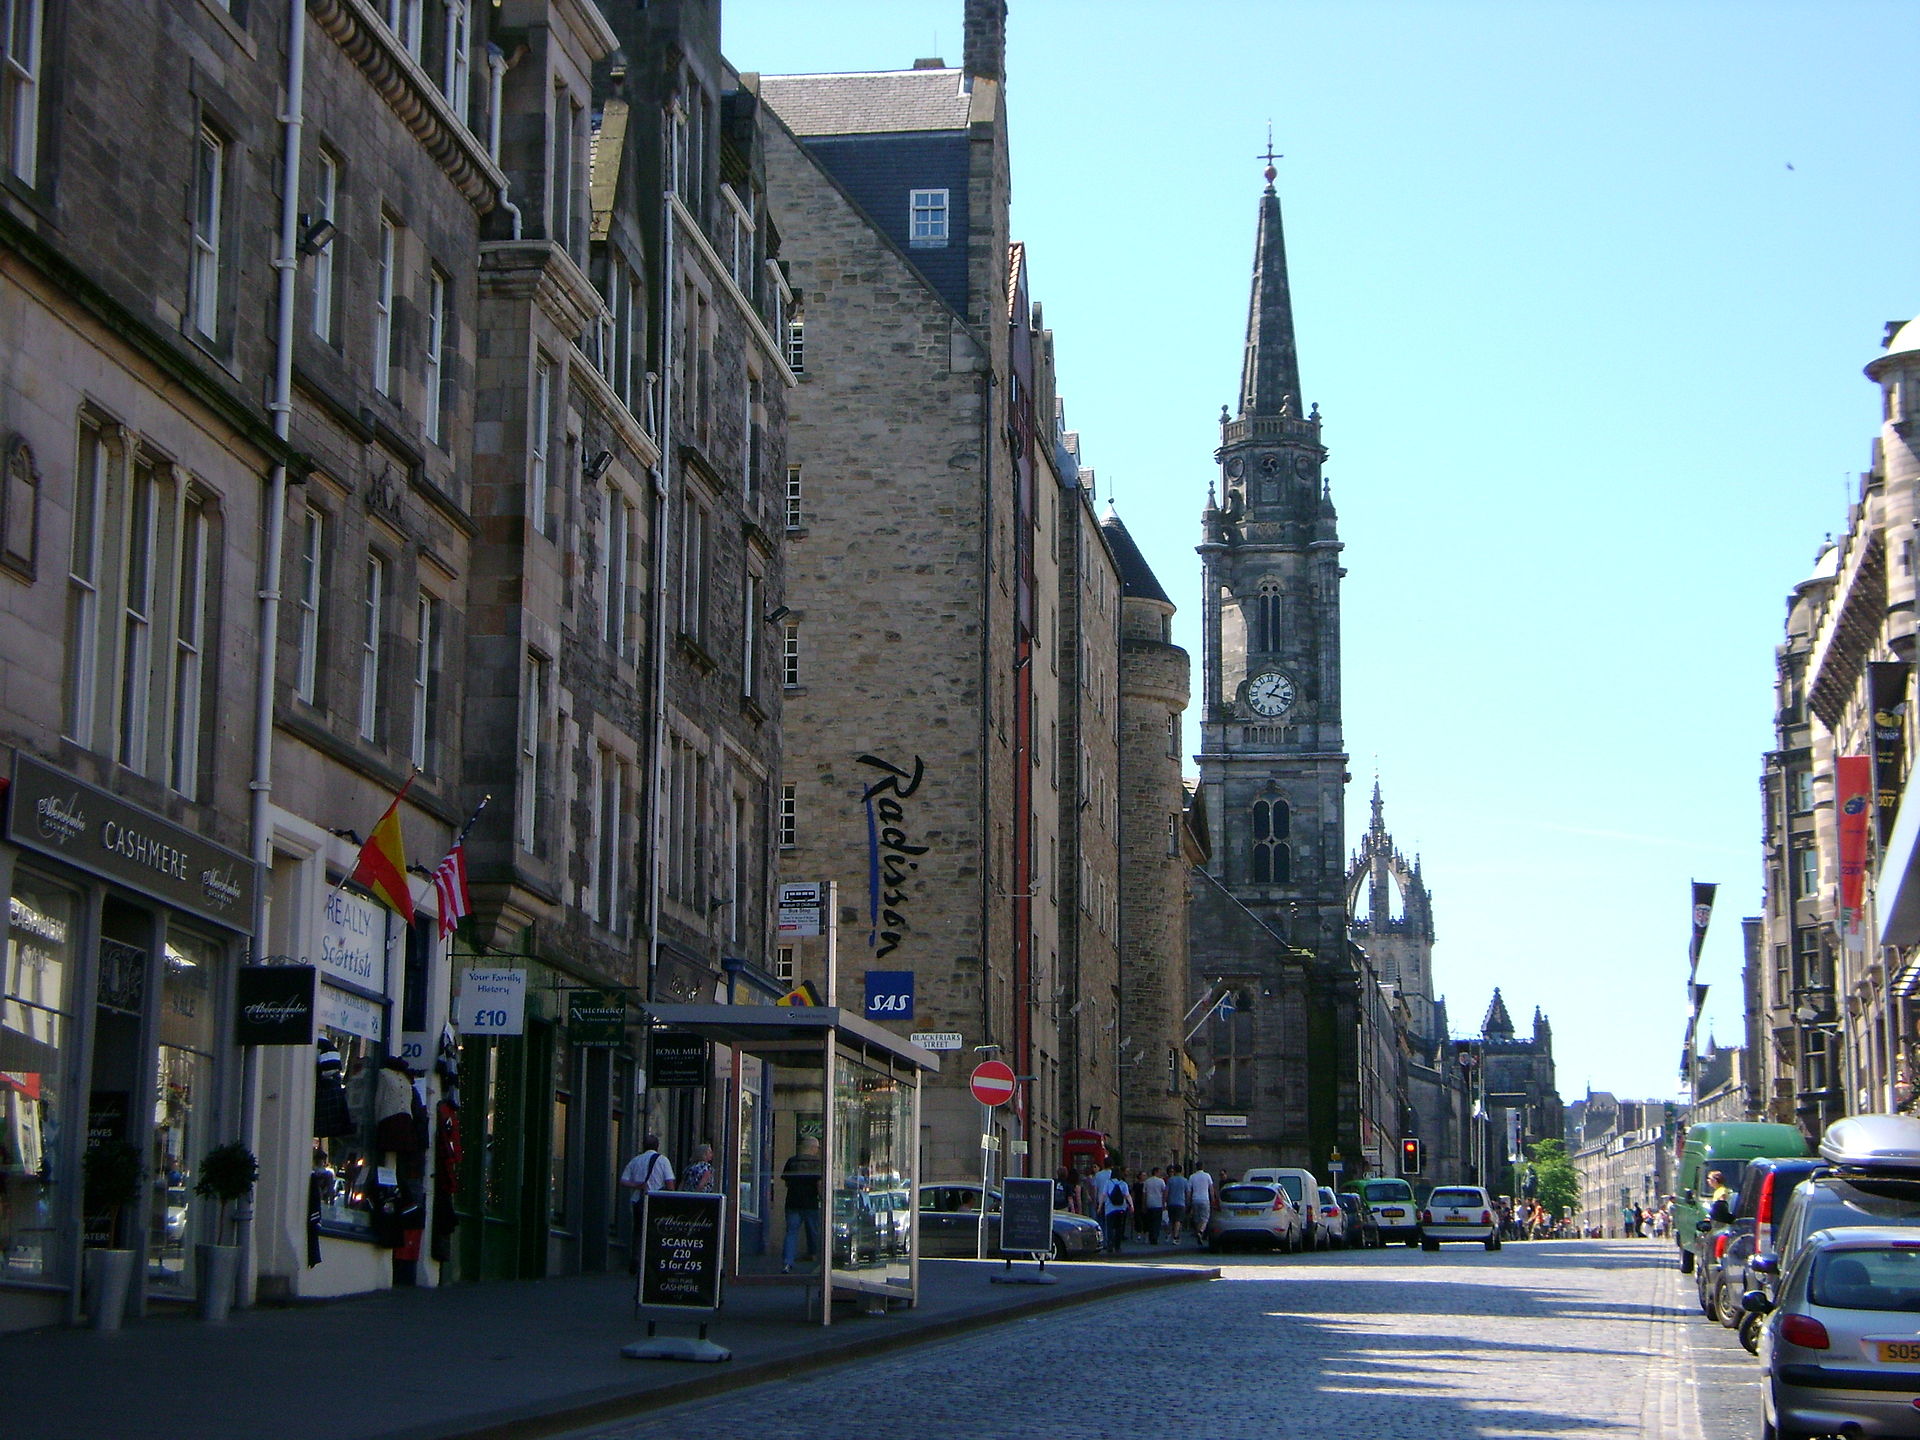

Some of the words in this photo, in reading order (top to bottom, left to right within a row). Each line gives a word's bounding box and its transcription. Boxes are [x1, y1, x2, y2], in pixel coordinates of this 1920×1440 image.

[104, 821, 188, 881] CASHMERE
[856, 755, 929, 958] Radisson
[327, 894, 371, 937] REALLY
[321, 935, 371, 978] Scottish
[469, 973, 489, 981] Your
[492, 971, 521, 984] Family
[477, 983, 510, 995] History
[868, 994, 911, 1011] SAS
[474, 1010, 507, 1026] £10
[401, 1043, 422, 1057] 20
[661, 1238, 704, 1248] SCARVES
[673, 1249, 691, 1259] £20
[659, 1260, 666, 1269] 5
[668, 1260, 683, 1269] for
[684, 1261, 702, 1271] £95
[659, 1282, 699, 1292] CASHMERE
